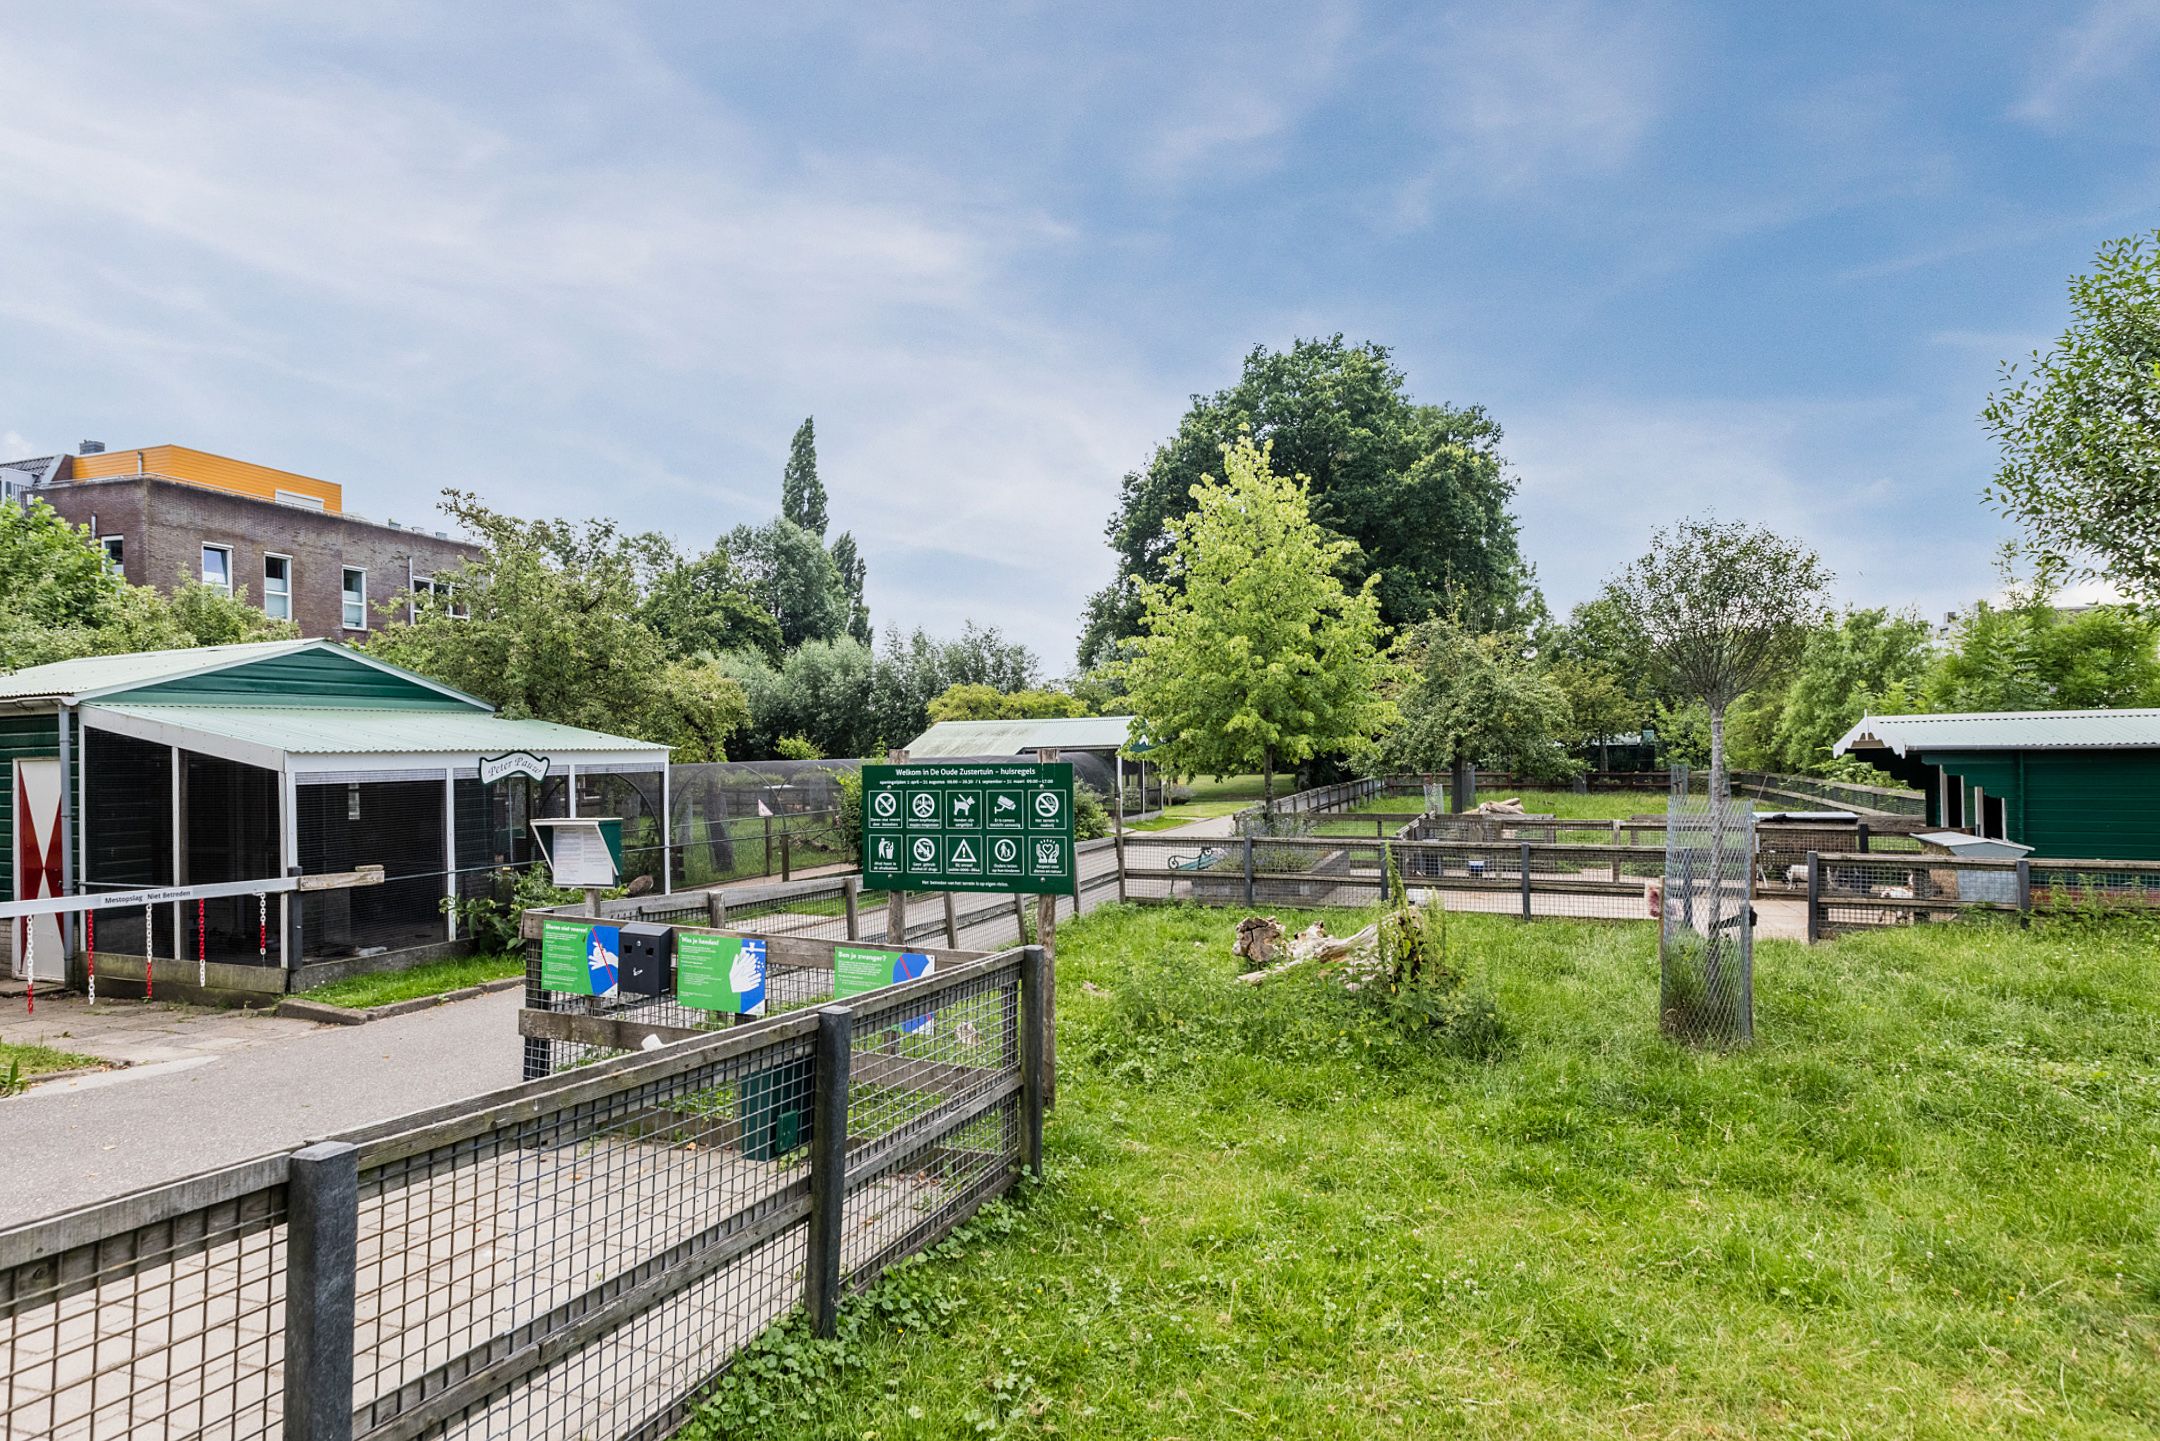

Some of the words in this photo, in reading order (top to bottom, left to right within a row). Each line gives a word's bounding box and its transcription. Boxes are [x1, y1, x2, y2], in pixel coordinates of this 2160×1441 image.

[488, 760, 512, 776] Peter
[515, 757, 541, 773] Pauw
[1000, 768, 1035, 776] huisregels
[105, 895, 143, 904] Mestopslag
